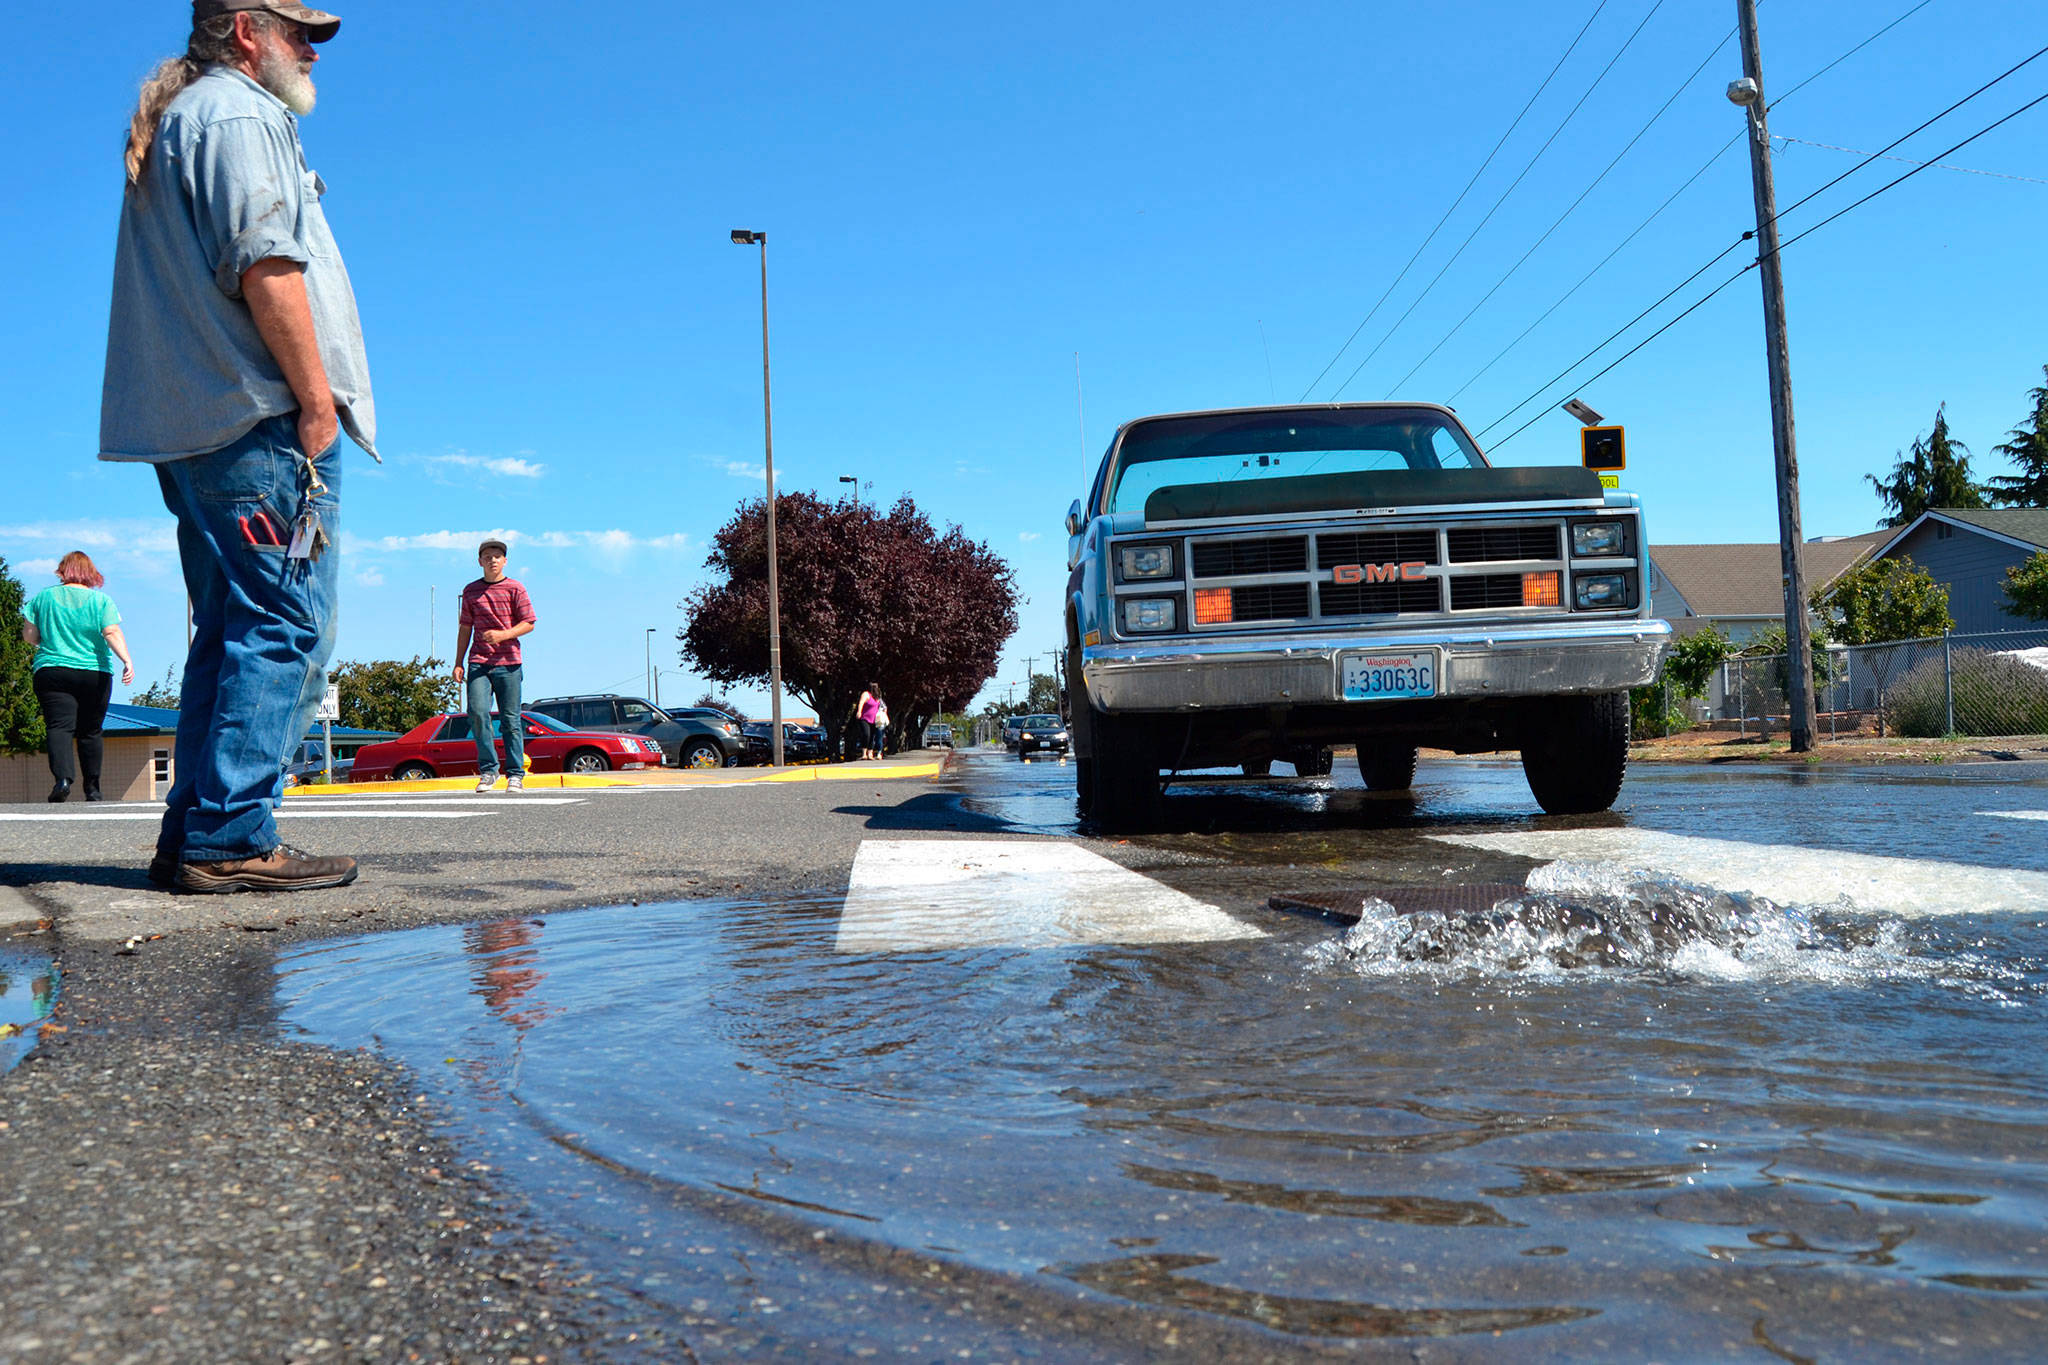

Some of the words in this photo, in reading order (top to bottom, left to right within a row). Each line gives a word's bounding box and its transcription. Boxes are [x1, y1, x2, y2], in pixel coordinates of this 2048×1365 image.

[1600, 479, 1616, 487] OOL
[1333, 561, 1428, 584] GMC
[1366, 658, 1412, 667] Washington
[1359, 667, 1431, 693] 33063C
[324, 689, 335, 699] XIT
